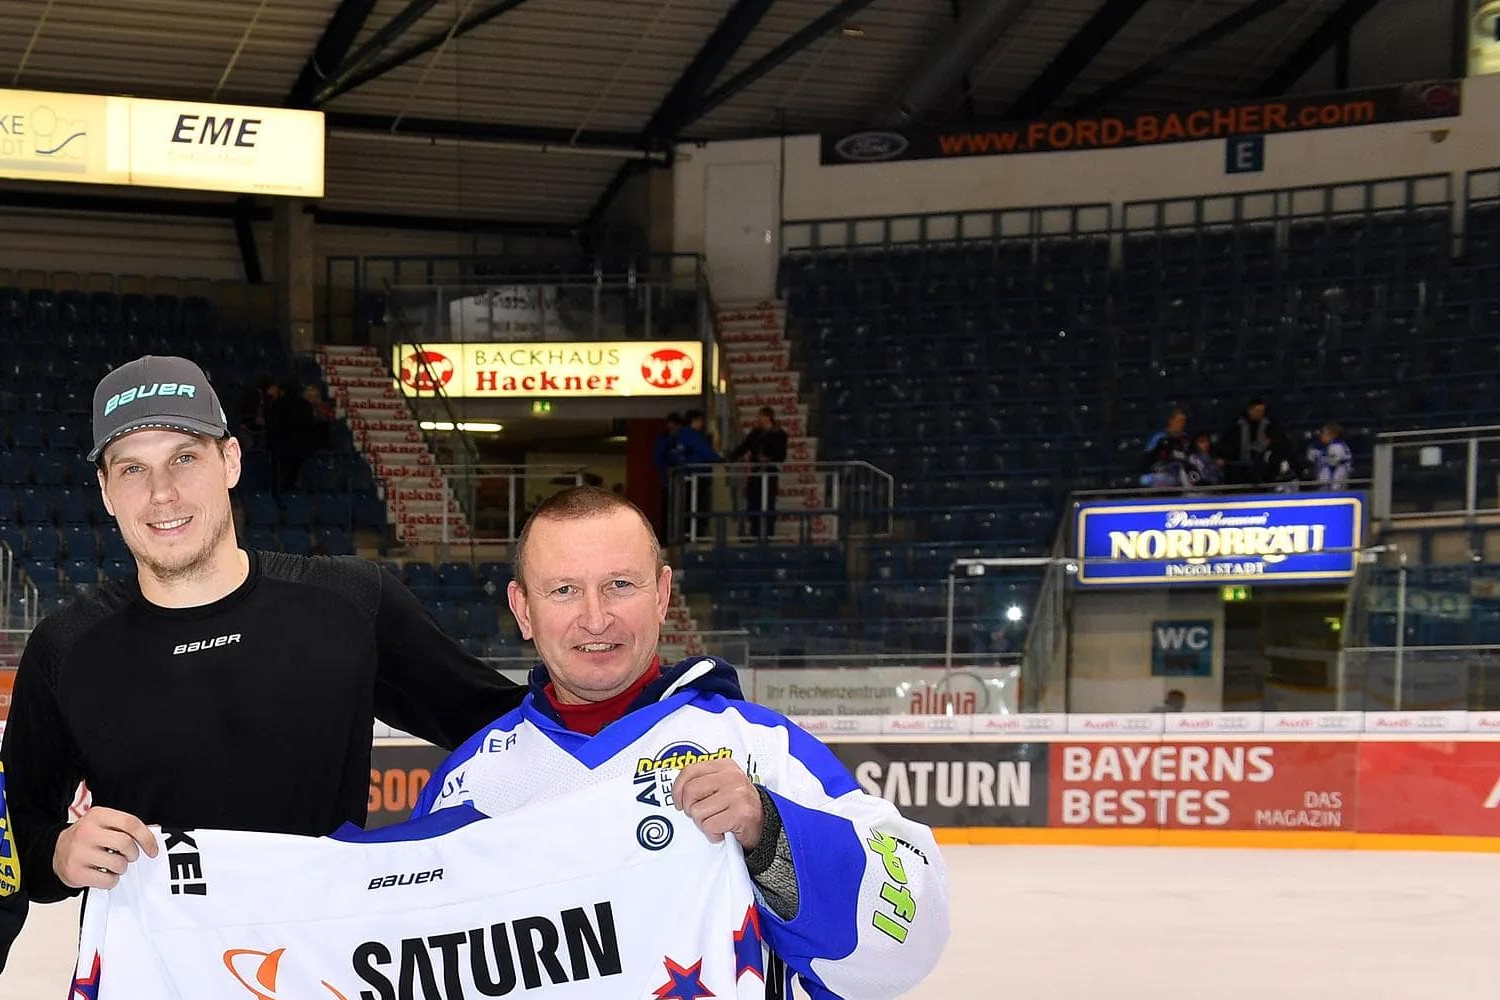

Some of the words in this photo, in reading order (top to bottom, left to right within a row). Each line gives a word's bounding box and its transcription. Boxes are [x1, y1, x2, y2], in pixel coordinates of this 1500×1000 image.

[171, 113, 263, 149] EME
[938, 99, 1375, 155] www.FORD-BACHER.com
[1234, 140, 1254, 169] E
[474, 348, 621, 367] BACKHAUS
[475, 370, 621, 392] Hackner
[1164, 561, 1267, 578] INGOLSTADT
[172, 632, 243, 656] BAUER
[1156, 625, 1209, 651] WC
[1062, 744, 1275, 784] BAYERNS
[856, 760, 1031, 810] SATURN
[1061, 787, 1231, 827] BESTES
[1304, 791, 1343, 810] DAS
[1254, 809, 1342, 828] MAGAZIN
[367, 866, 445, 890] BAUER
